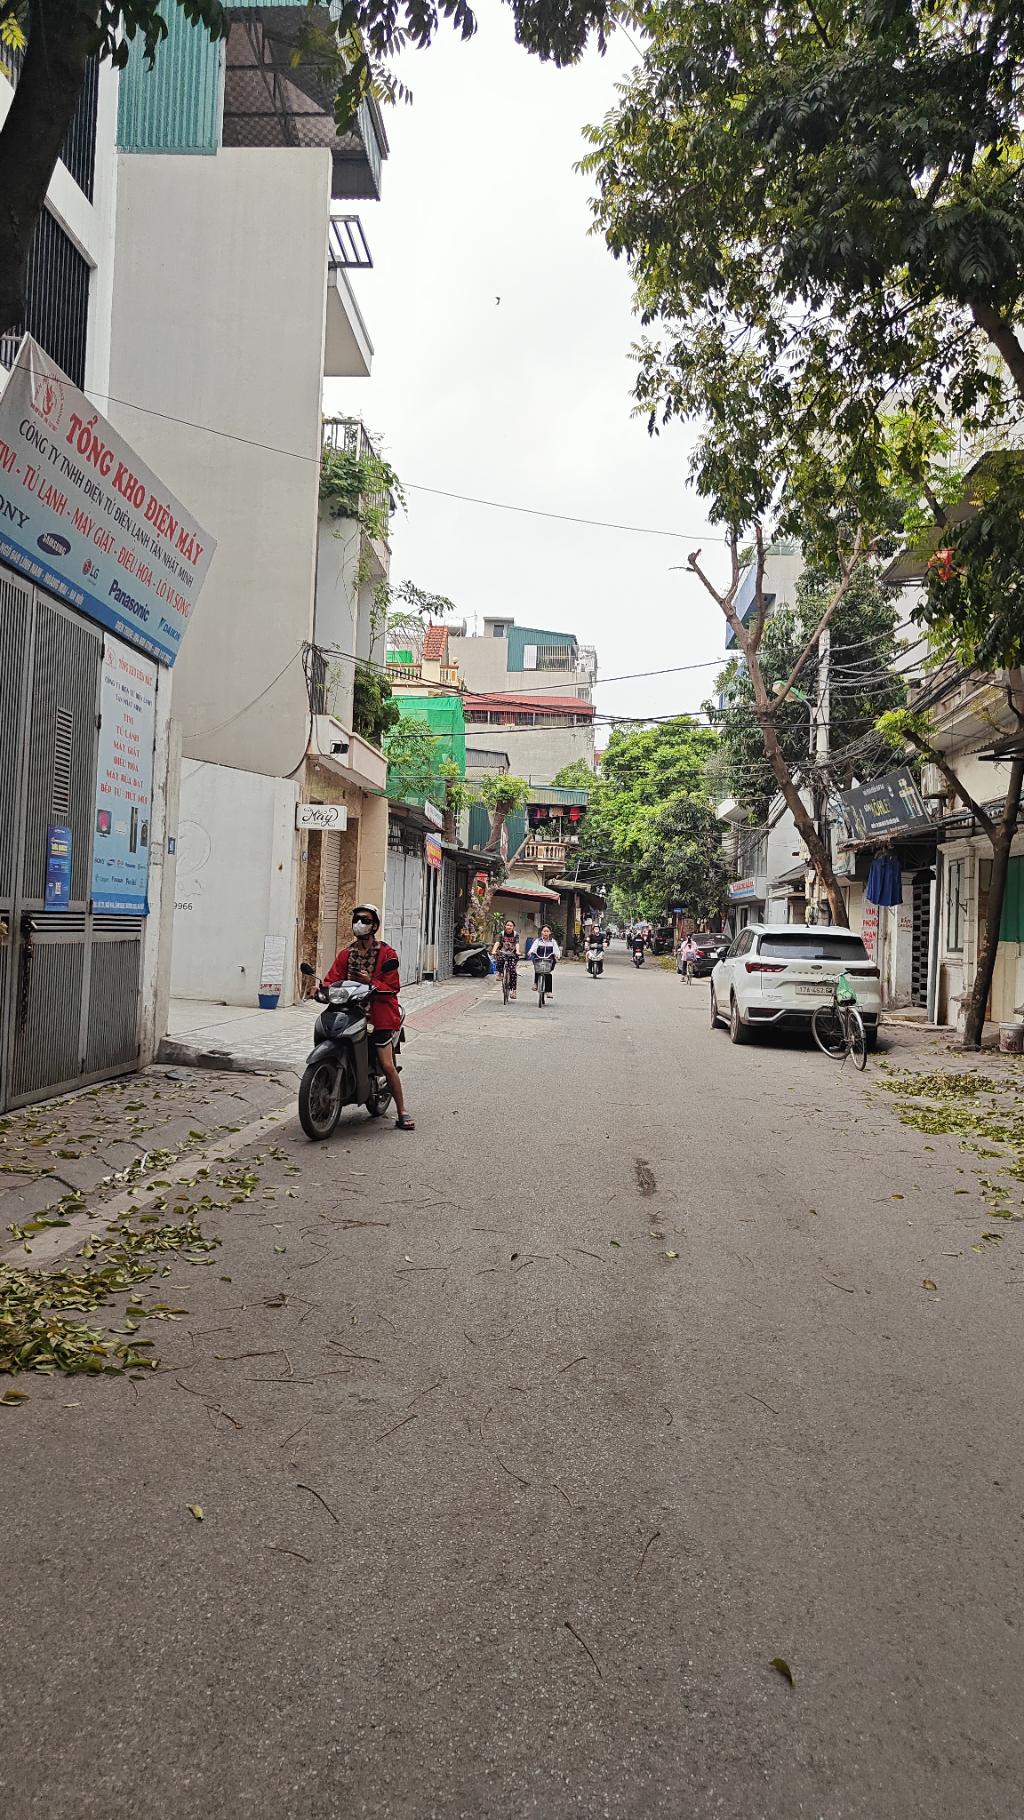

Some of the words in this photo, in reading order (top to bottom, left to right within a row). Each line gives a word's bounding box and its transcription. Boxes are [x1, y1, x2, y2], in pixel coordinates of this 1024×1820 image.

[19, 419, 49, 454] CÔNG
[48, 444, 62, 465] TY
[59, 455, 85, 489] TNHH
[83, 482, 105, 506] ĐIỆN
[113, 507, 132, 532] ĐIỆN
[131, 523, 151, 548] LẠNH
[177, 566, 194, 588] MINH
[22, 464, 41, 492] TỦ
[37, 478, 68, 516] LẠNH
[71, 507, 96, 538] MÁY
[93, 527, 116, 555] GIẶT
[117, 545, 138, 573] ĐIỀU
[166, 586, 175, 605] VI
[172, 593, 192, 618] SÓNG
[42, 533, 67, 556] SAMSUNG
[66, 413, 115, 477] TỔNG
[111, 462, 146, 509] KHO
[144, 495, 178, 542] ĐIỆN
[175, 527, 204, 566] MÁY
[108, 579, 150, 622] Panasonic
